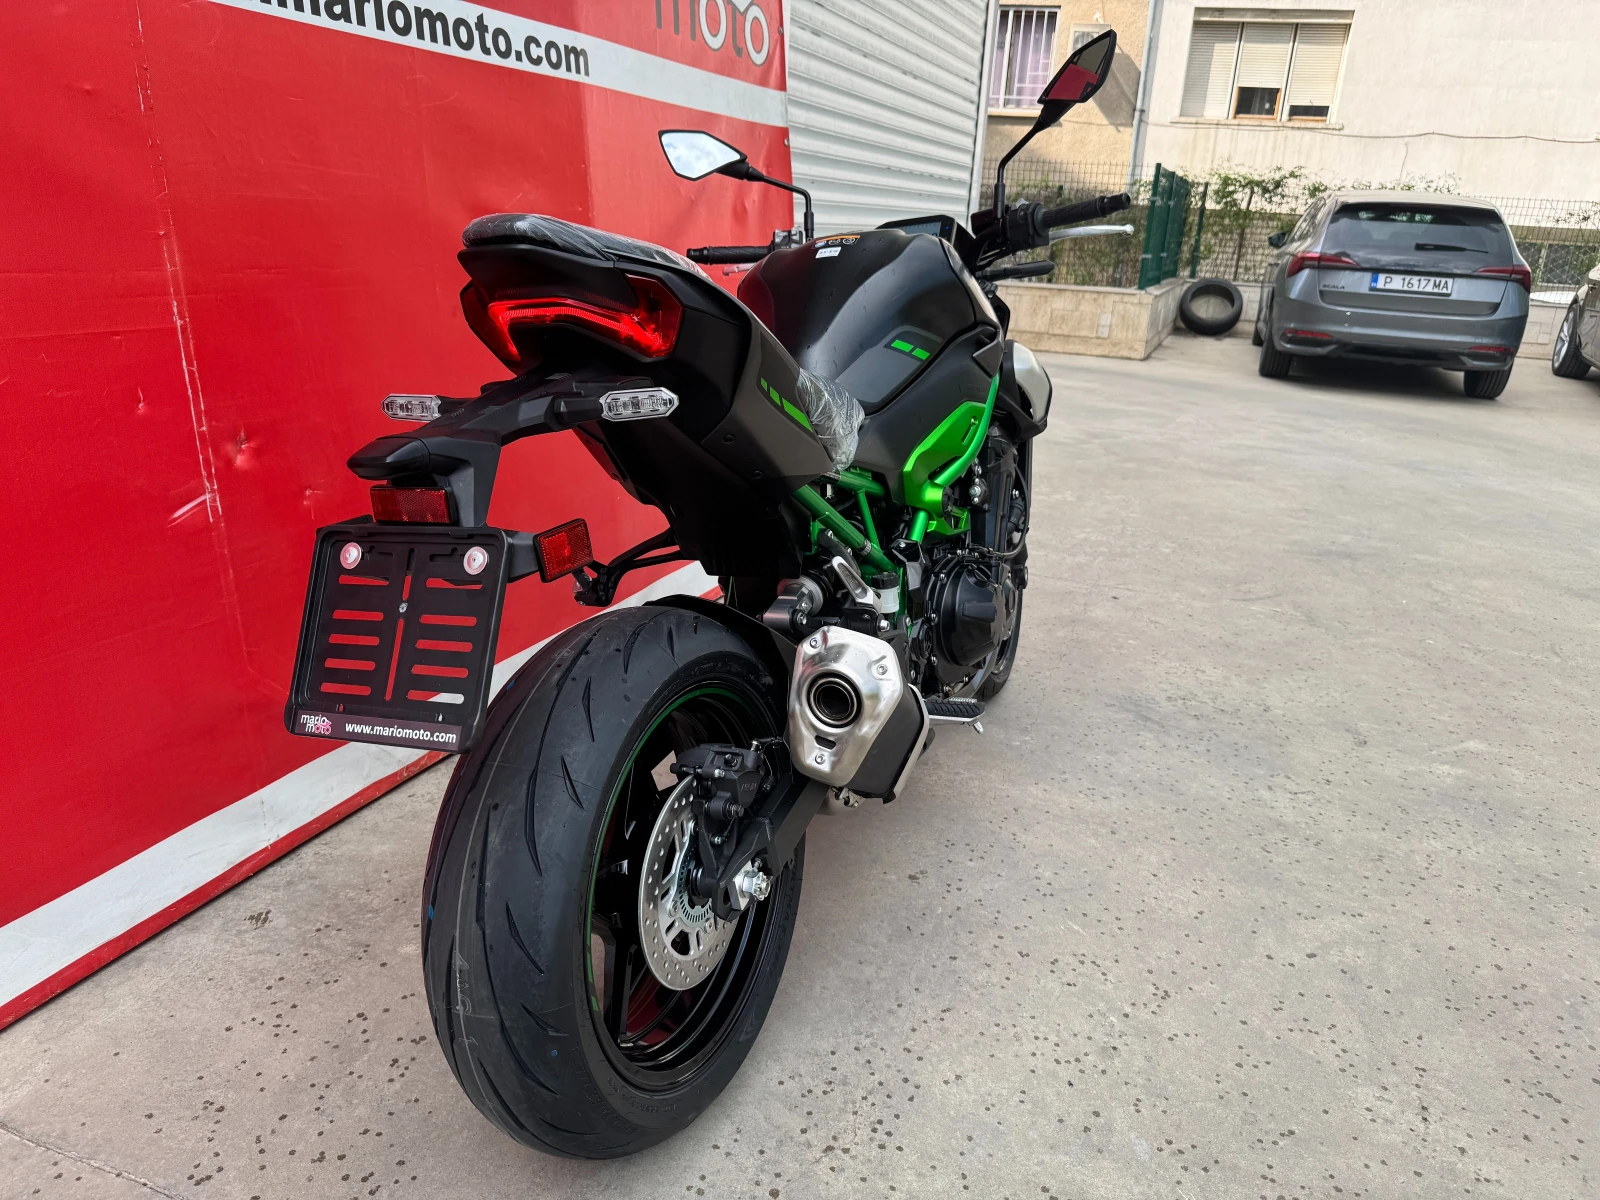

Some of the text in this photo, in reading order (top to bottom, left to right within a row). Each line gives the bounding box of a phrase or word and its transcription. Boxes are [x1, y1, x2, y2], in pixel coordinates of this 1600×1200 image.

[1383, 275, 1393, 288] P
[300, 714, 328, 725] mario
[305, 723, 332, 735] moto
[345, 721, 457, 744] www.mariomoto.com
